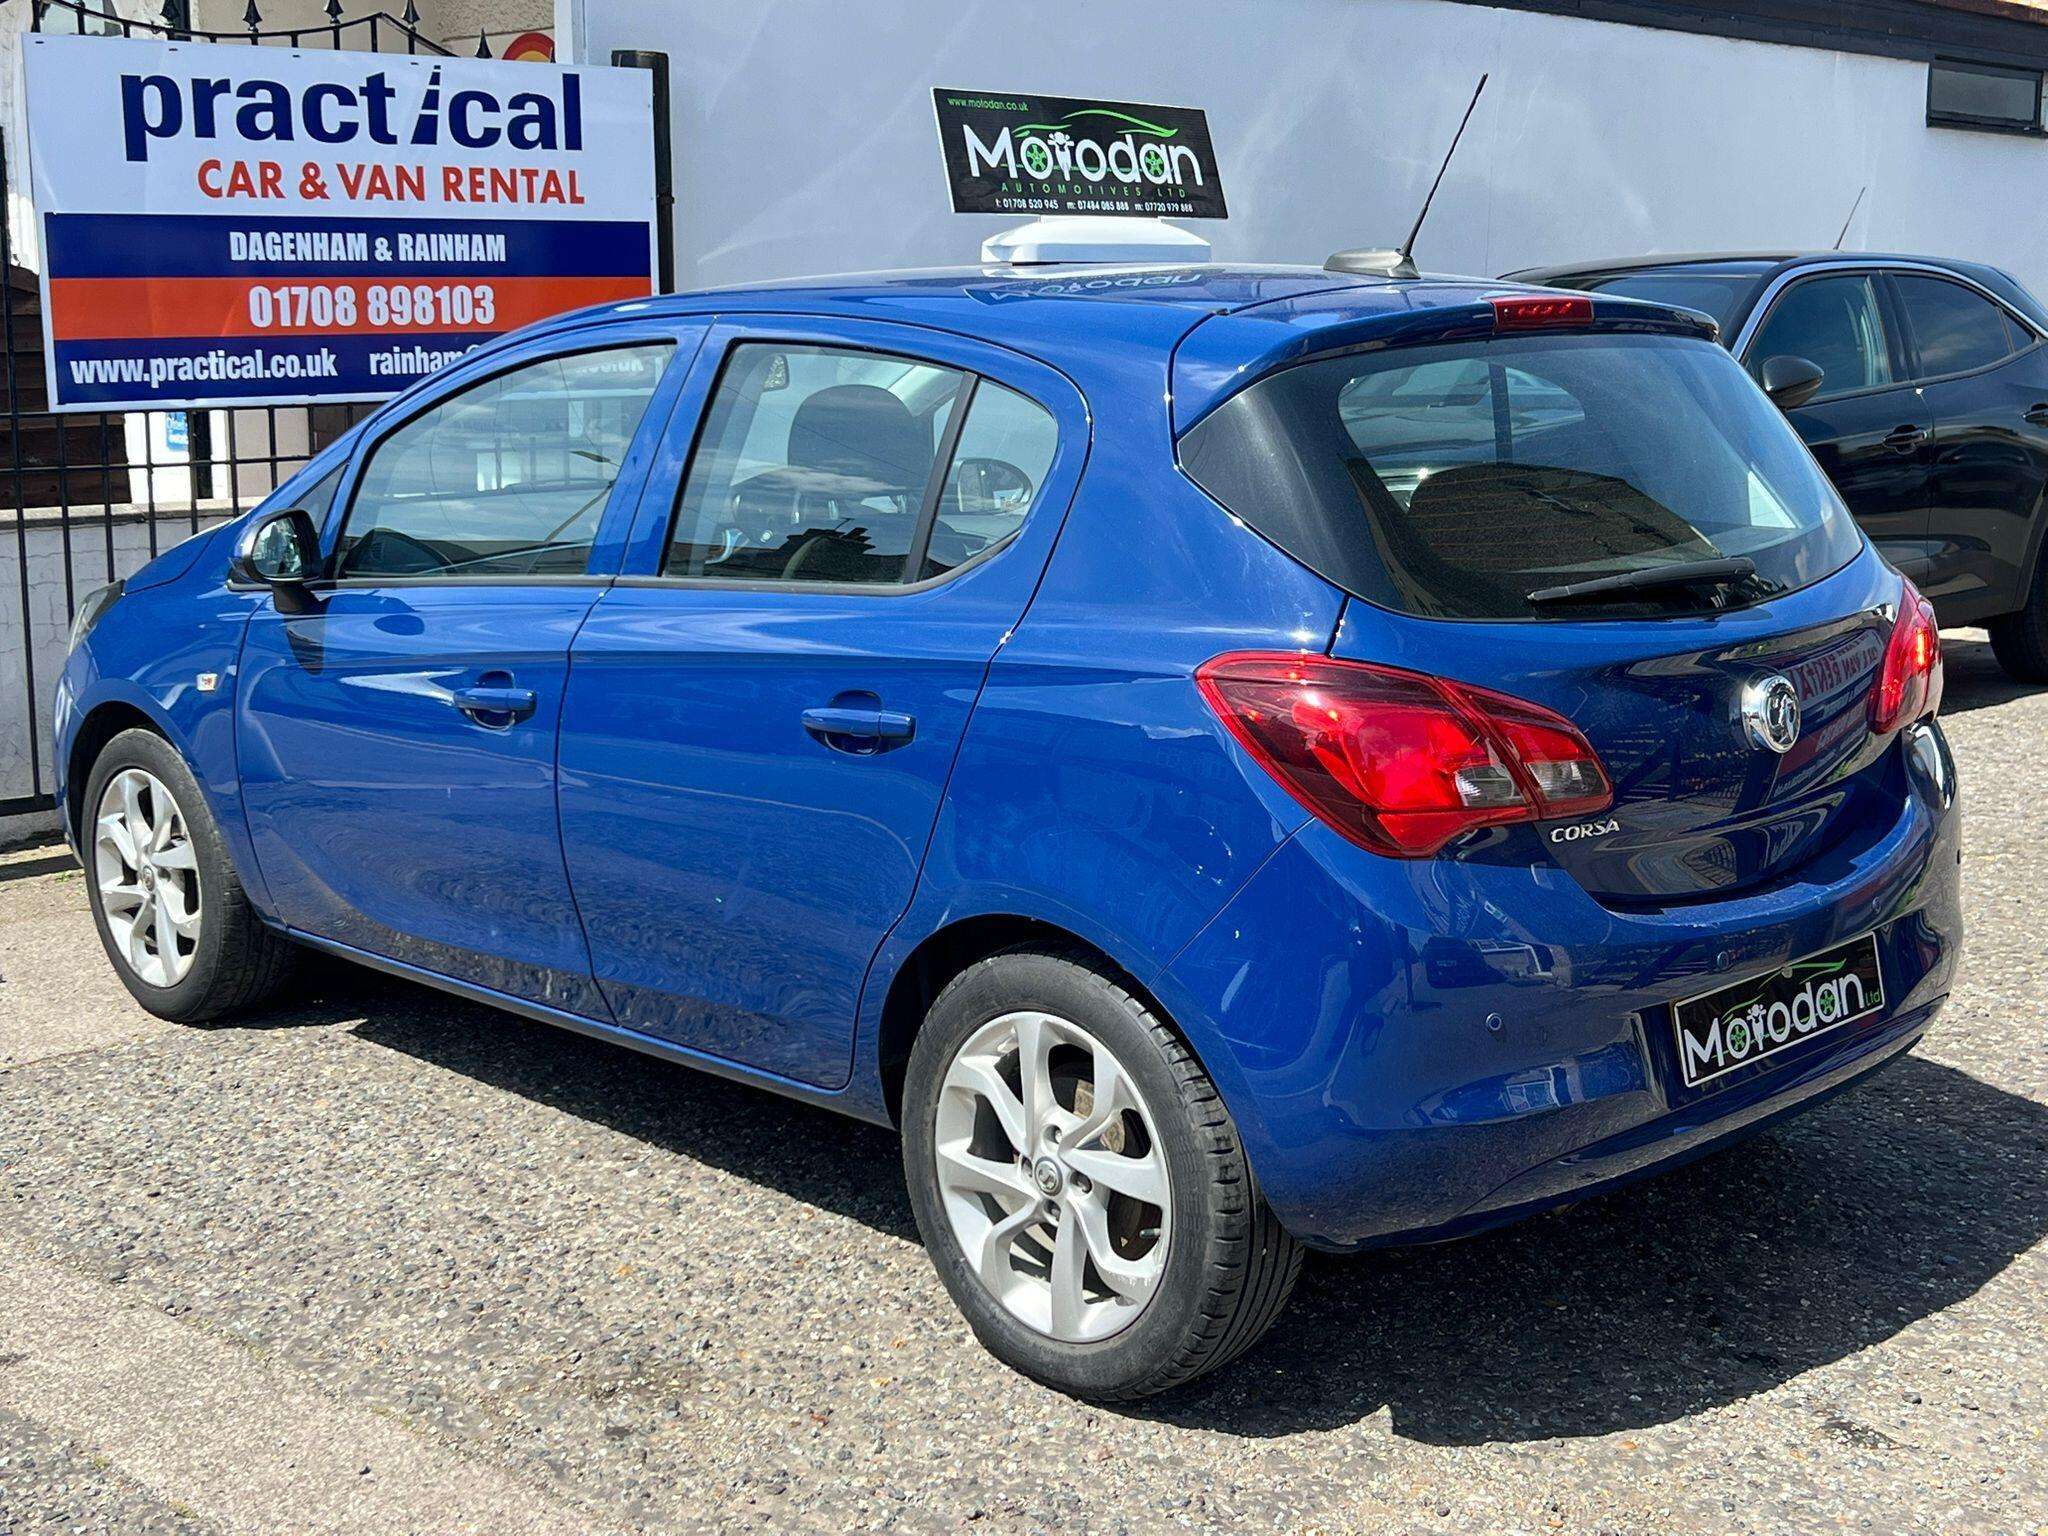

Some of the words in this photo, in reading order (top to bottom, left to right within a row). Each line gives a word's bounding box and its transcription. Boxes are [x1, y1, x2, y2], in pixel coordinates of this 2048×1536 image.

[120, 64, 583, 162] practical
[946, 97, 1030, 112] www.motodan.co.uk
[962, 123, 1204, 187] Motodan
[197, 159, 285, 198] CAR
[299, 161, 330, 200] &
[336, 163, 425, 201] VAN
[442, 166, 585, 205] RENTAL
[1001, 182, 1142, 197] AUTOMOTIVES
[1156, 187, 1186, 199] LTD
[1003, 198, 1027, 209] 01708
[1028, 199, 1043, 209] 520
[229, 231, 369, 262] DAGENHAM
[374, 237, 394, 262] &
[398, 232, 507, 262] RAINHAM
[249, 285, 358, 328] 01708
[367, 284, 496, 326] 898103
[69, 347, 339, 389] www.practical.co.uk
[1550, 818, 1620, 843] CORSA
[1683, 973, 1865, 1079] Motodan
[1865, 987, 1881, 1007] Ltd
